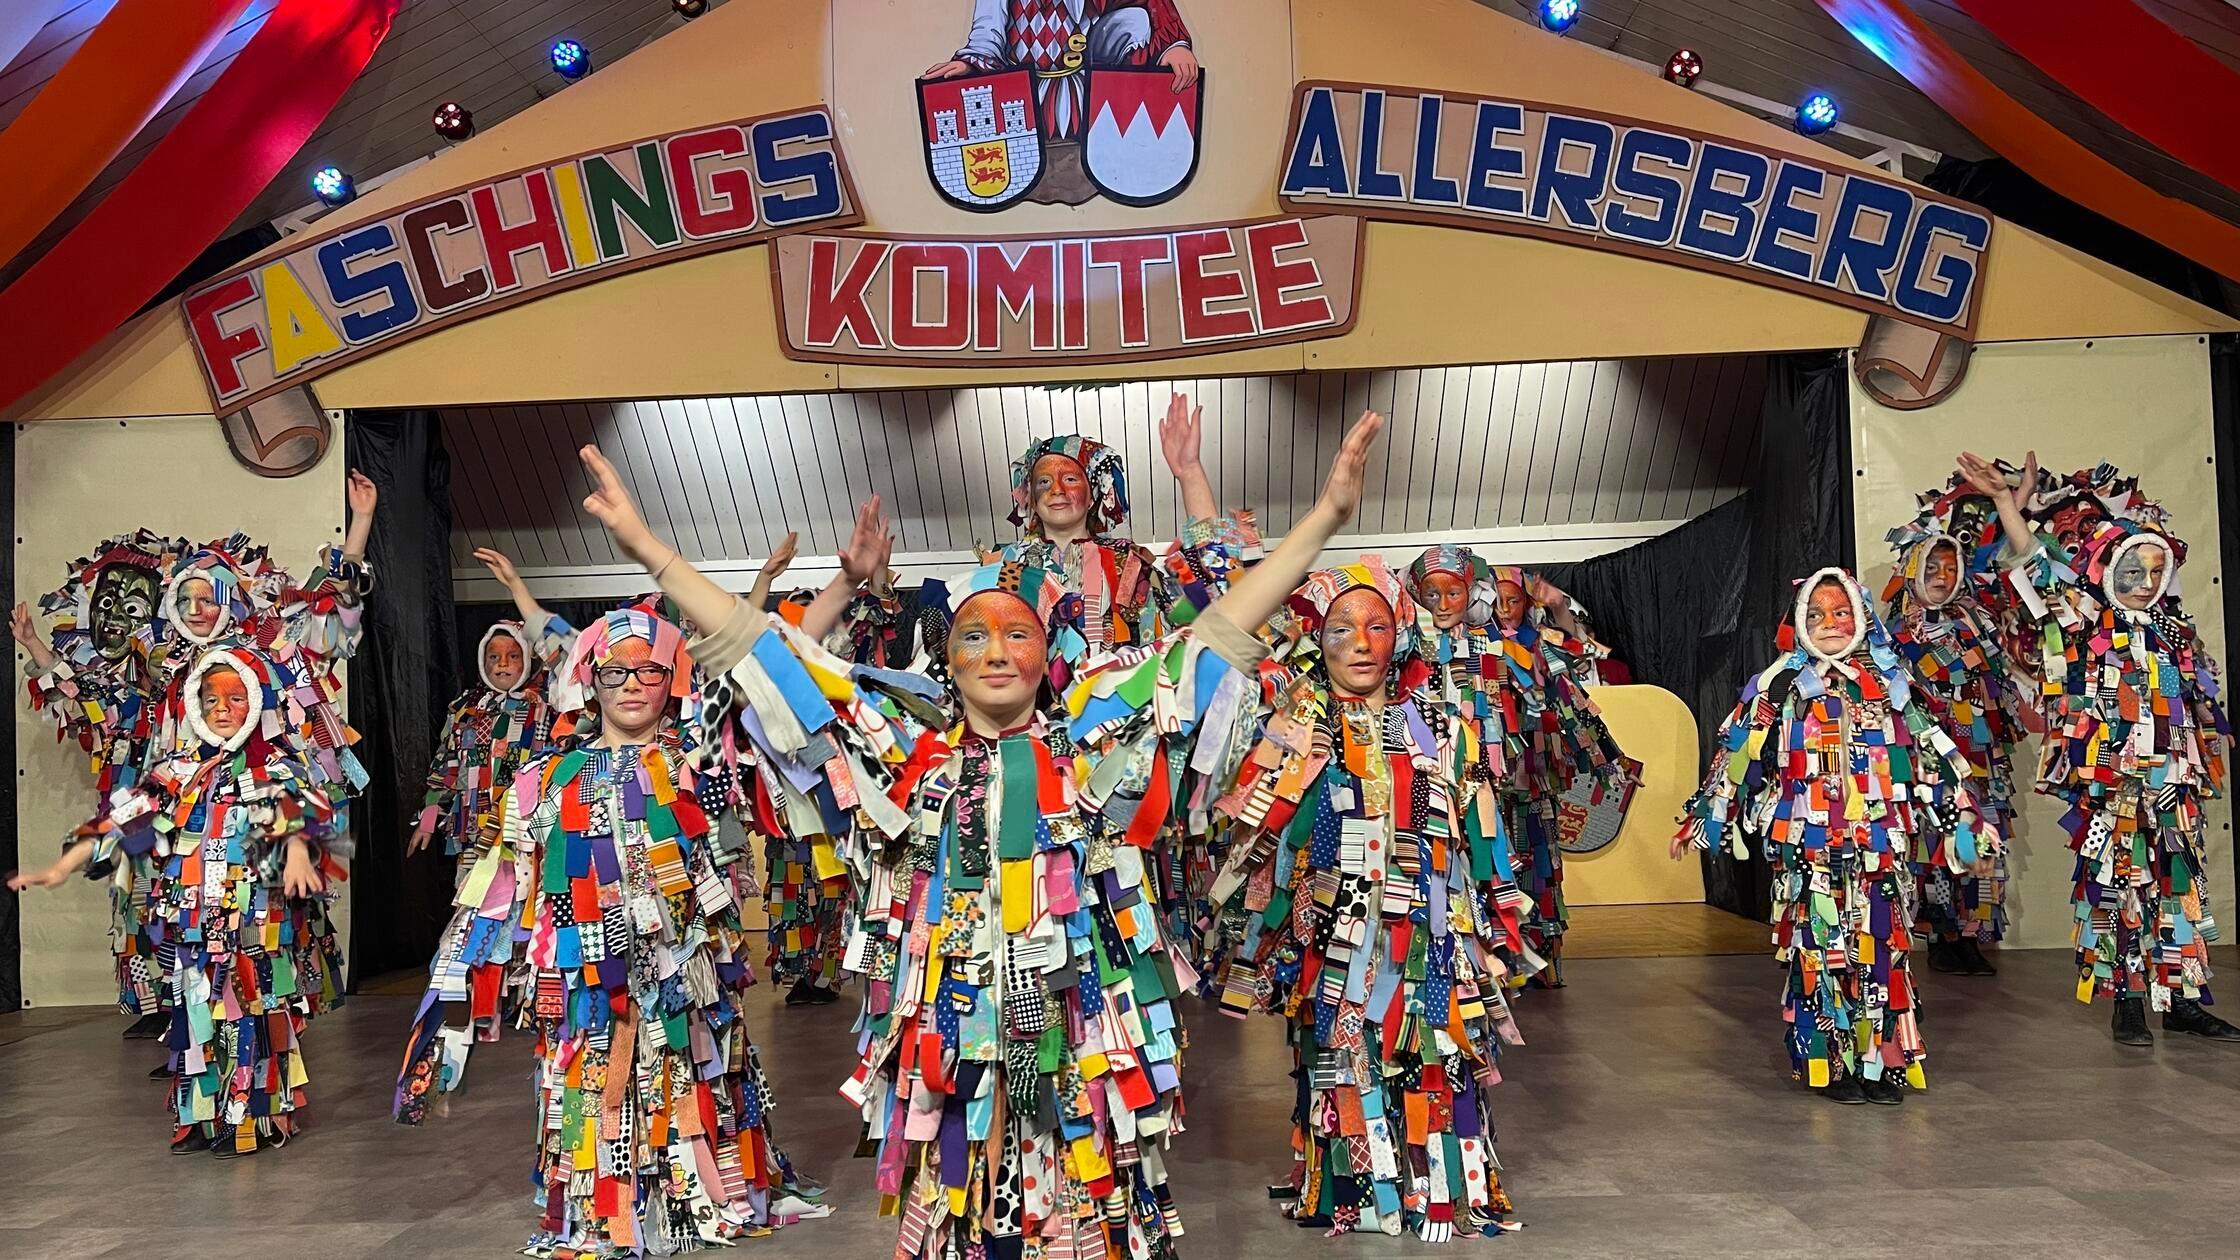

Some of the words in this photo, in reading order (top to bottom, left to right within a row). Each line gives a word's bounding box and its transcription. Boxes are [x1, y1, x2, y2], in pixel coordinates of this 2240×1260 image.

[184, 110, 843, 398] FASCHINGS
[803, 220, 1336, 351] KOMITEE
[1279, 87, 1991, 323] ALLERSBERG
